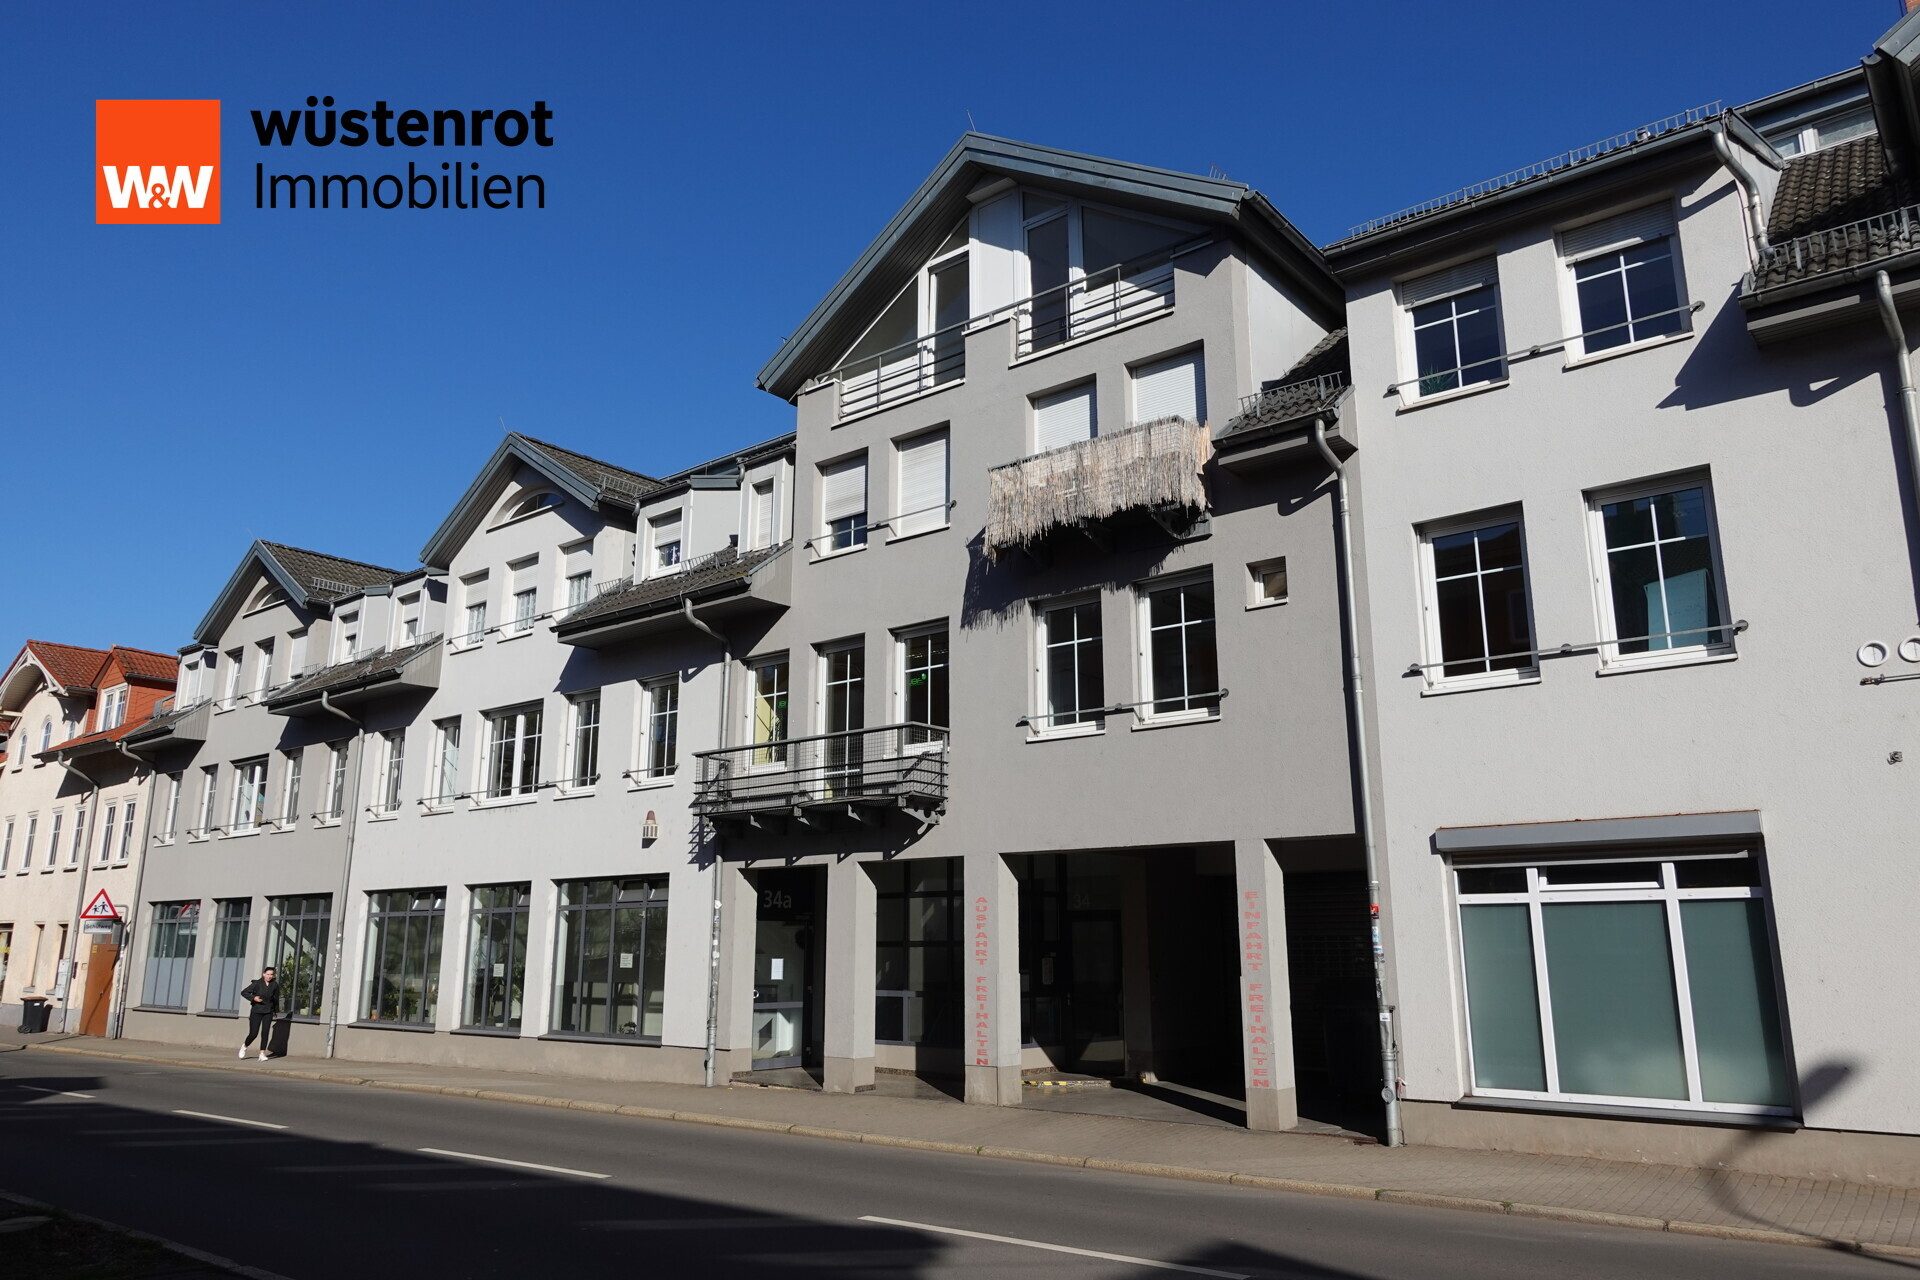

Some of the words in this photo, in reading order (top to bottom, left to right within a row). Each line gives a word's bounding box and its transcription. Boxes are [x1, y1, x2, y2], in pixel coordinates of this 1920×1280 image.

[763, 889, 792, 909] 34a
[975, 896, 989, 966] AUSFAHRT
[1243, 891, 1264, 971] EINFAHRT
[975, 975, 990, 1067] FREIHALTEN
[1248, 983, 1271, 1088] FREIHALTEN
